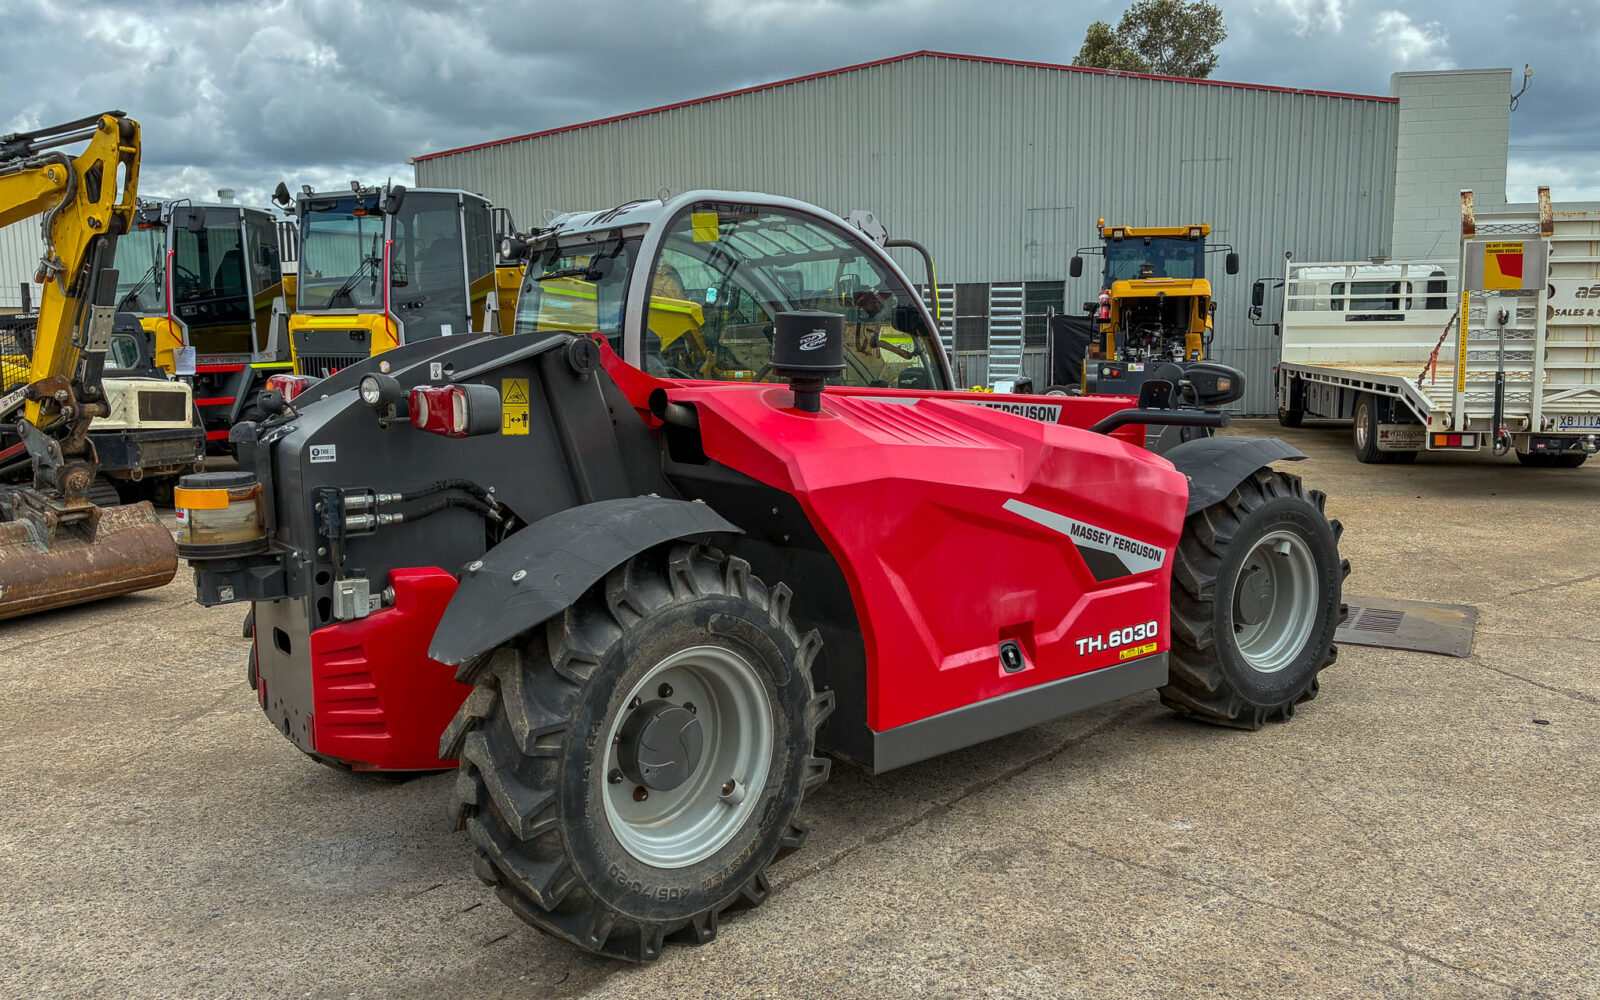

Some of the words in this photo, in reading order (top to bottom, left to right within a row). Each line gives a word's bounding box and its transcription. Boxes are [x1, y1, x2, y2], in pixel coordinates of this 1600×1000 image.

[1554, 308, 1585, 317] SALES
[1586, 308, 1595, 317] &
[799, 335, 818, 344] TOP
[809, 337, 828, 347] SPIN
[985, 403, 1057, 422] RGUSON
[1070, 522, 1112, 546] MASSEY
[1112, 536, 1162, 562] FERGUSON
[1075, 619, 1158, 656] TH.6030
